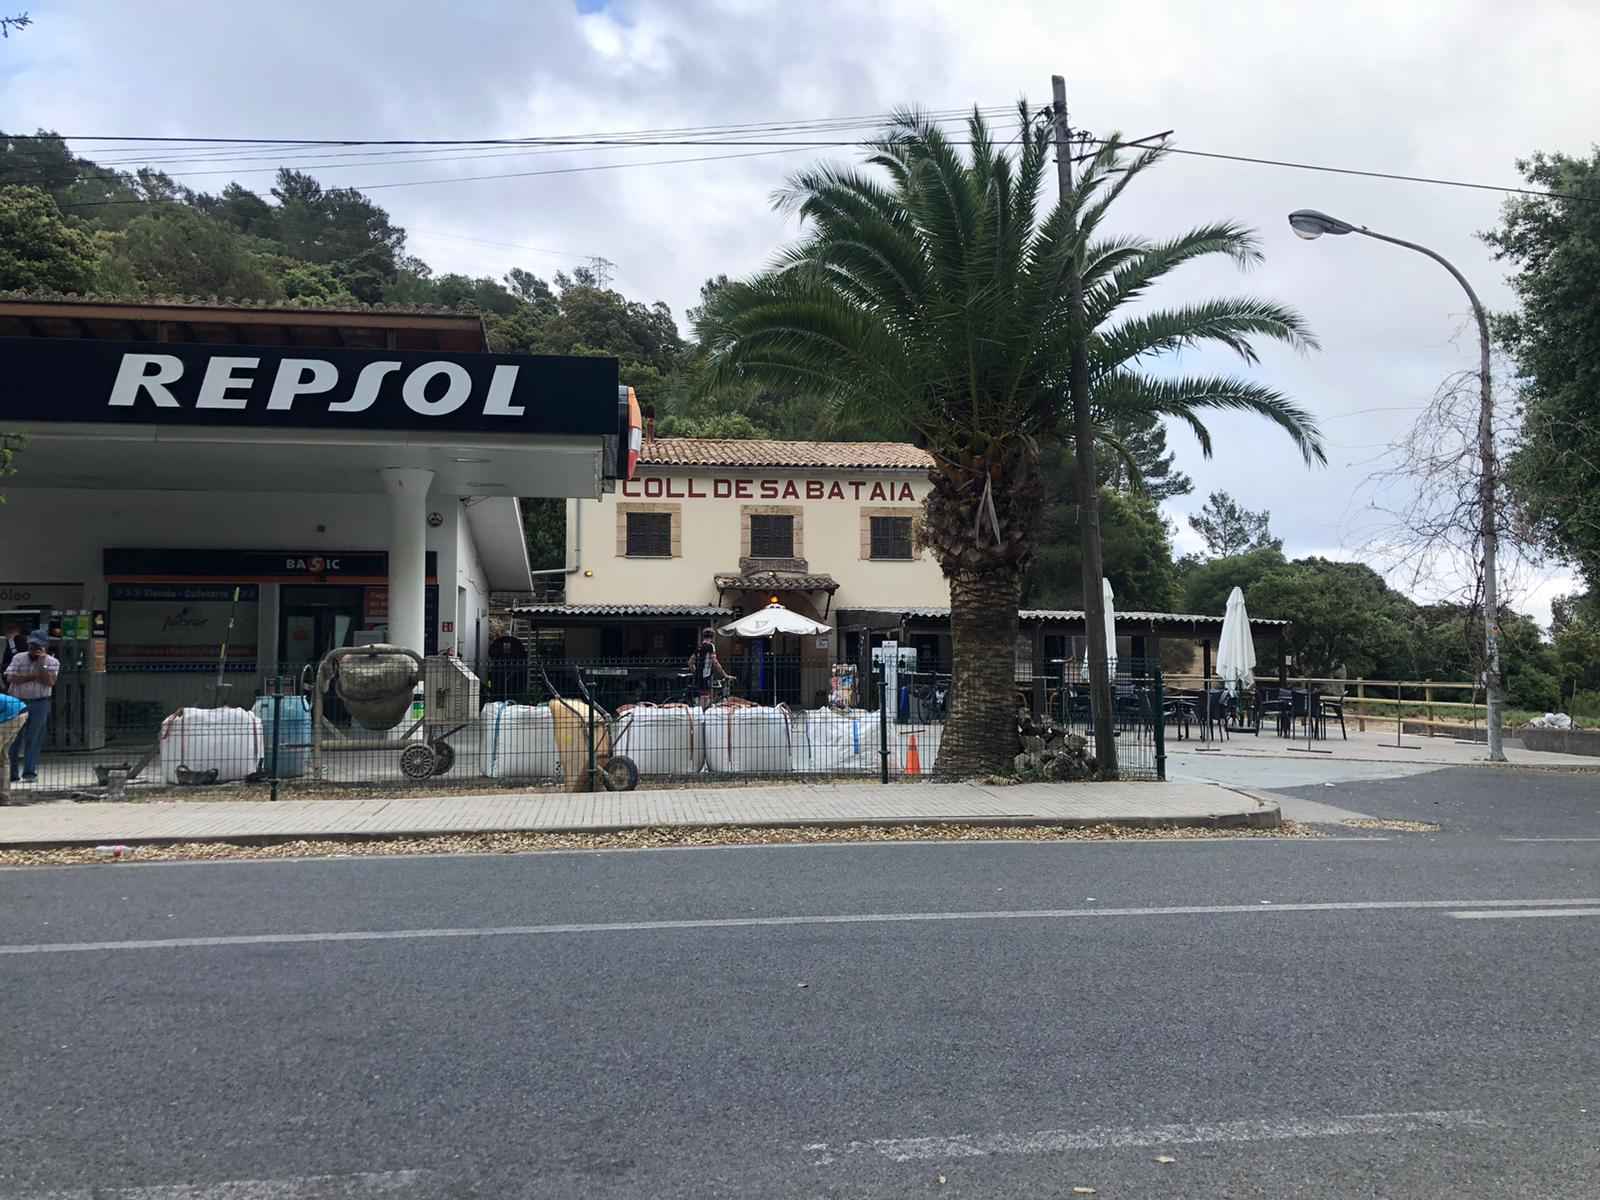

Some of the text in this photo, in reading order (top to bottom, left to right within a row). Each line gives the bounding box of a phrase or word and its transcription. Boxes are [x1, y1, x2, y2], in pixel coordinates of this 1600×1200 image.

[109, 353, 526, 416] REPSOL
[623, 477, 706, 497] COLL
[713, 479, 754, 498] DE
[806, 481, 913, 501] BATAIA
[285, 559, 341, 573] BASIC
